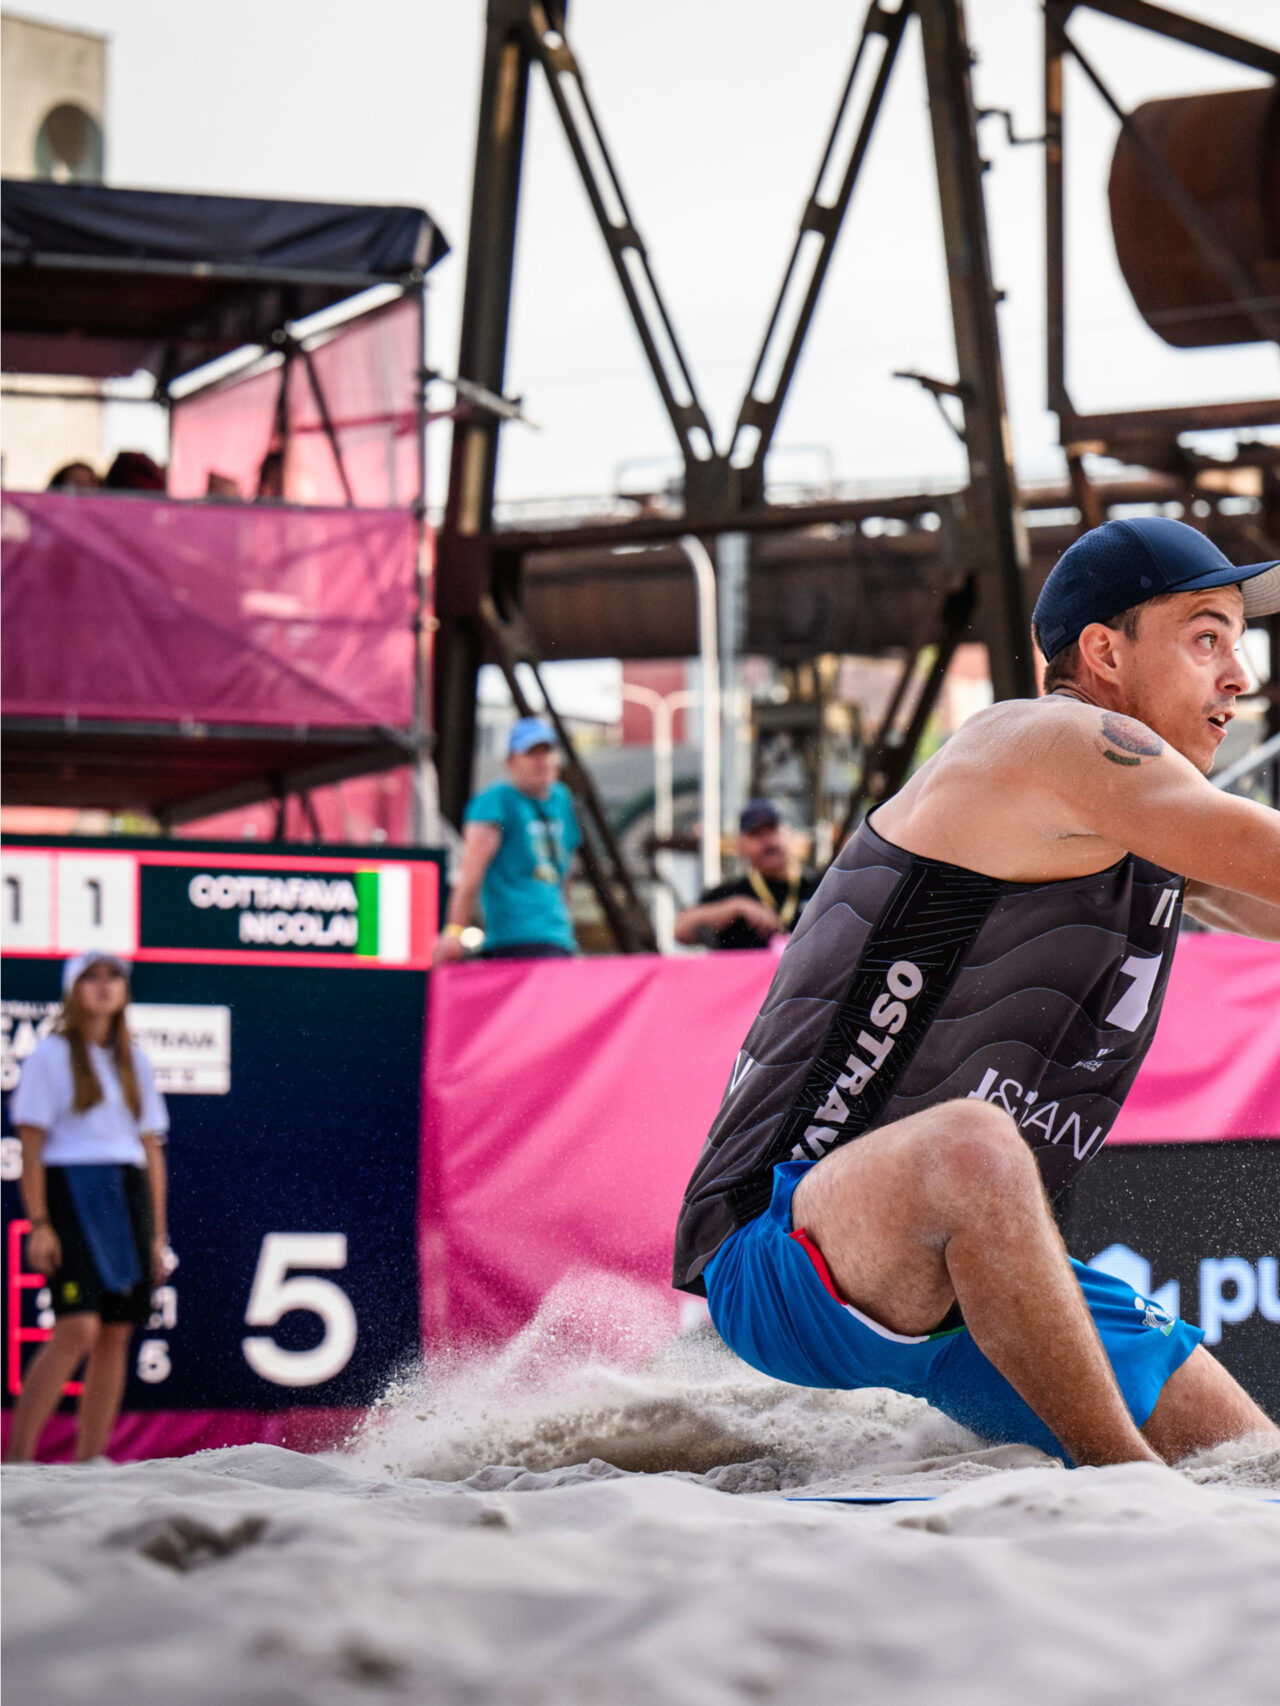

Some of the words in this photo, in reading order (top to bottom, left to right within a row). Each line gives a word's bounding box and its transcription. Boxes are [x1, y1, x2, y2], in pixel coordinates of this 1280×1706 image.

[87, 878, 102, 926] 1
[1149, 887, 1180, 929] IT
[1104, 951, 1164, 1033] 1
[242, 1233, 357, 1387] 5
